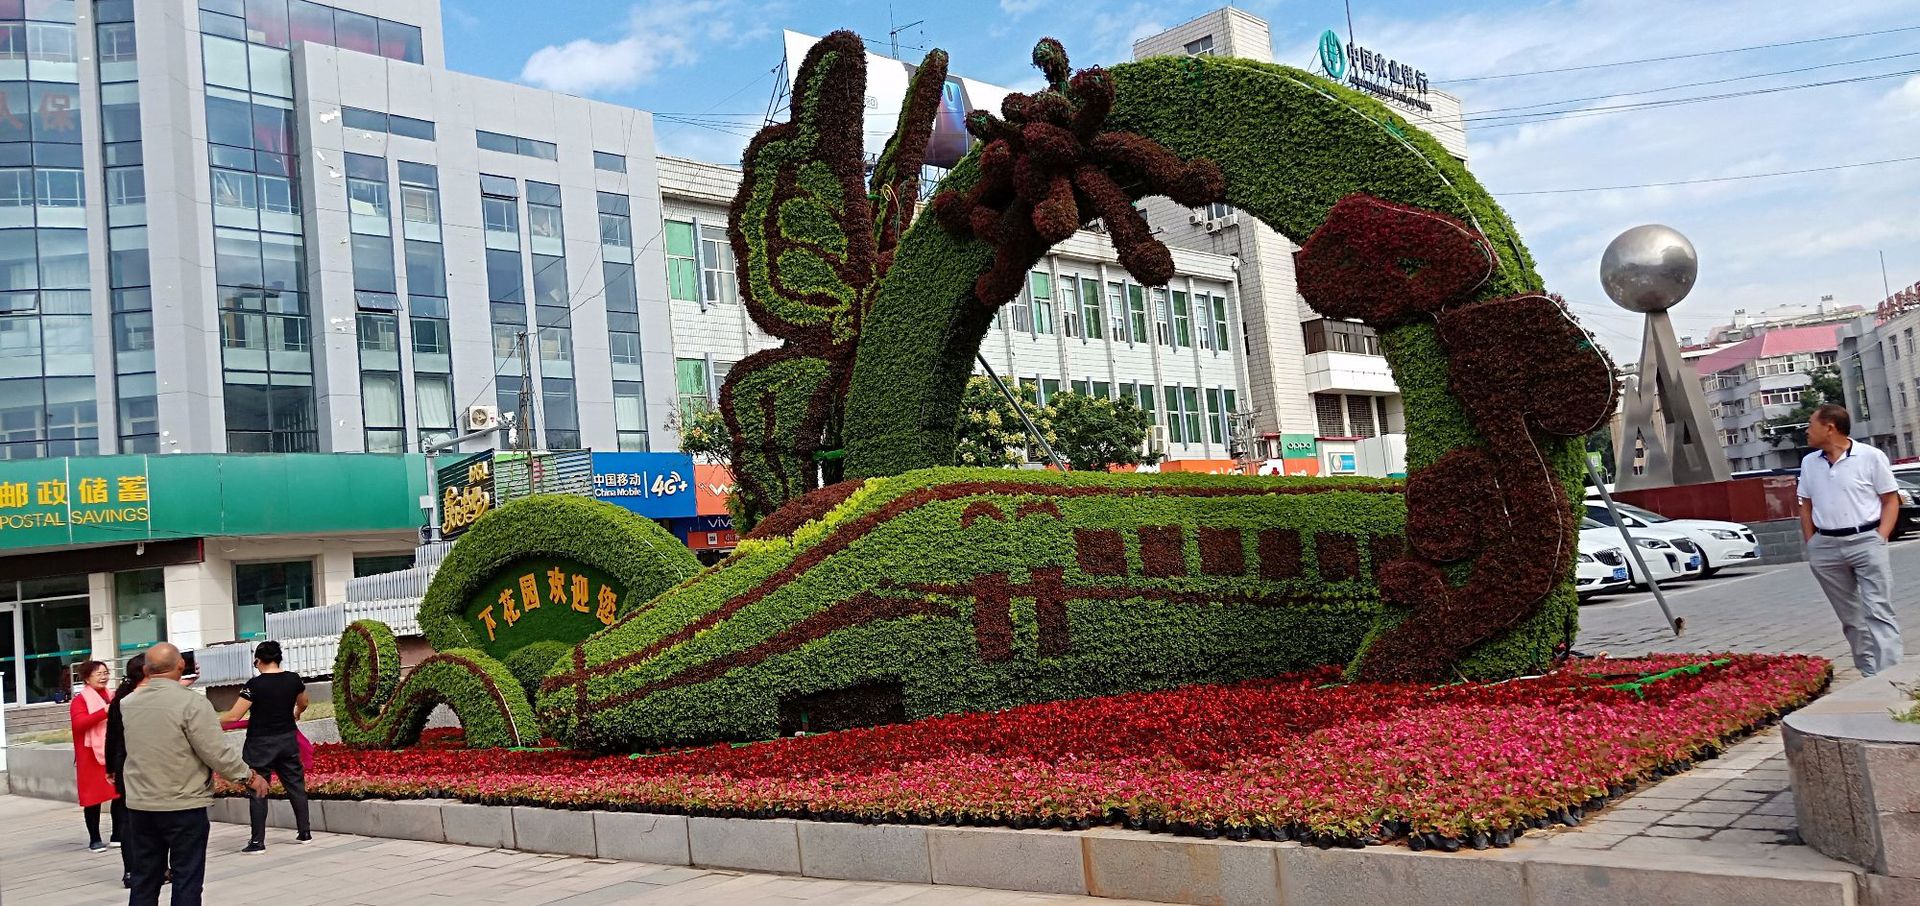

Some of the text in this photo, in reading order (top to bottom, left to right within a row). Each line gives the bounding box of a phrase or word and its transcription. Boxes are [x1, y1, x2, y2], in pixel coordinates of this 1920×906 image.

[1346, 41, 1430, 94] 中国农业银行
[594, 473, 641, 487] 中国移动
[0, 475, 147, 508] 邮政储蓄
[594, 487, 641, 497] China Mobile
[0, 507, 148, 529] POSTAL SAVINGS
